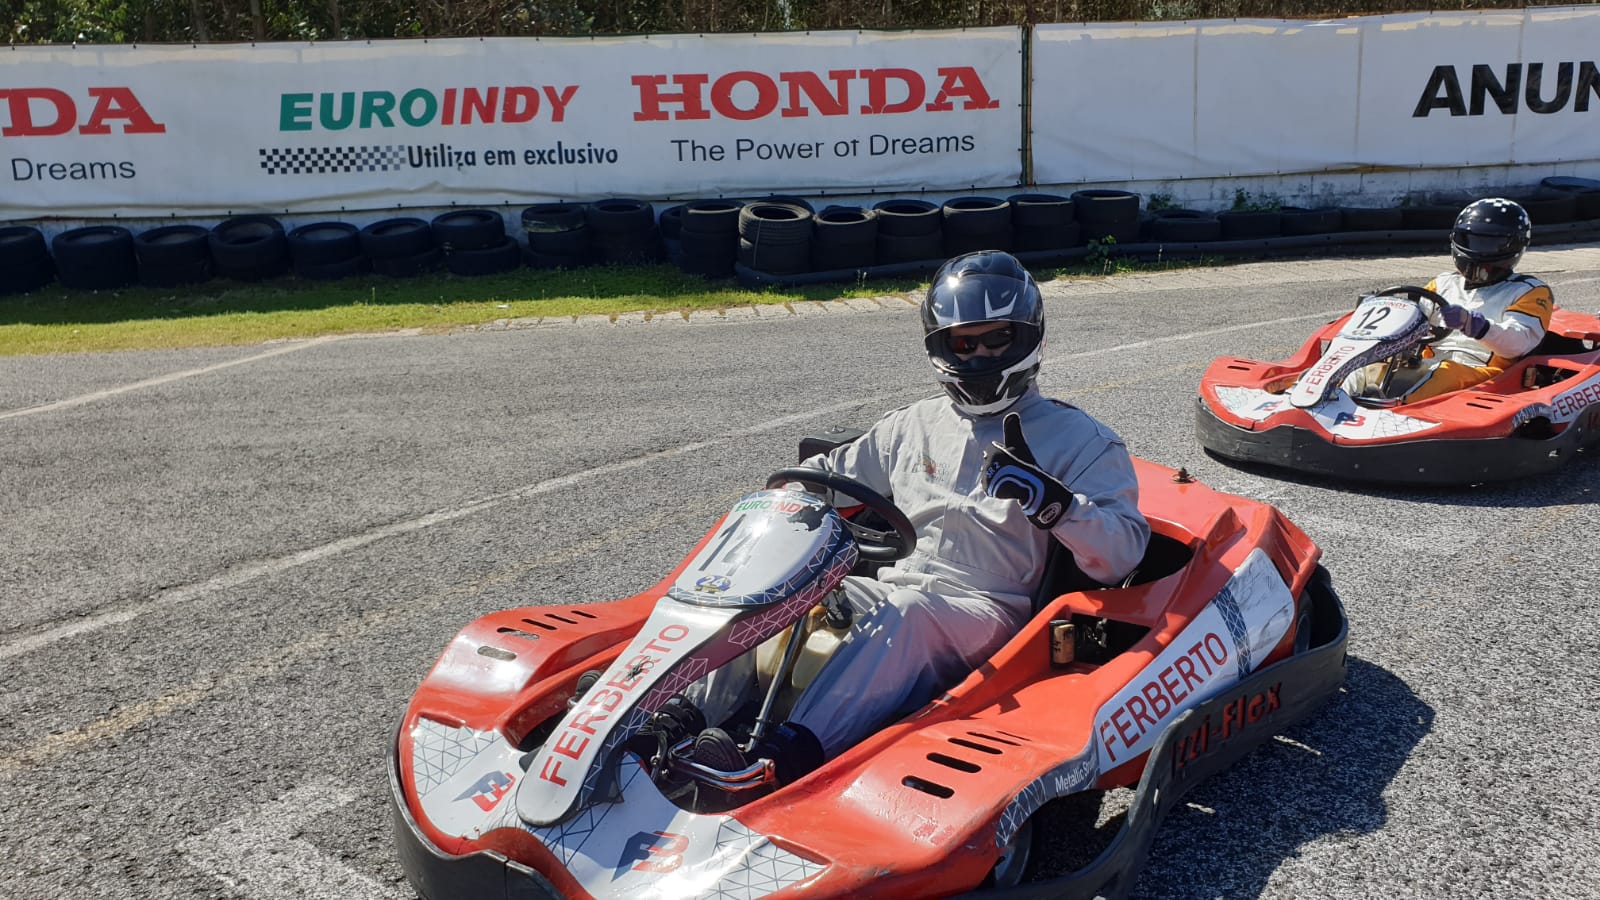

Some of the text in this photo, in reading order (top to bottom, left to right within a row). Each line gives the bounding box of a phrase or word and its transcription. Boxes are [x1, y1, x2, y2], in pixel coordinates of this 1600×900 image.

[0, 87, 166, 137] DA
[279, 85, 580, 132] EUROINDY
[631, 66, 1000, 122] HONDA
[407, 141, 619, 168] Utiliza em exclusivo
[670, 139, 725, 162] The
[736, 138, 824, 161] Power
[870, 134, 975, 156] Dreams
[11, 158, 136, 182] Dreams
[1356, 306, 1391, 330] 12
[735, 501, 806, 514] EUROIND
[539, 623, 690, 787] FERBERTO
[1099, 632, 1229, 763] FERBERTO
